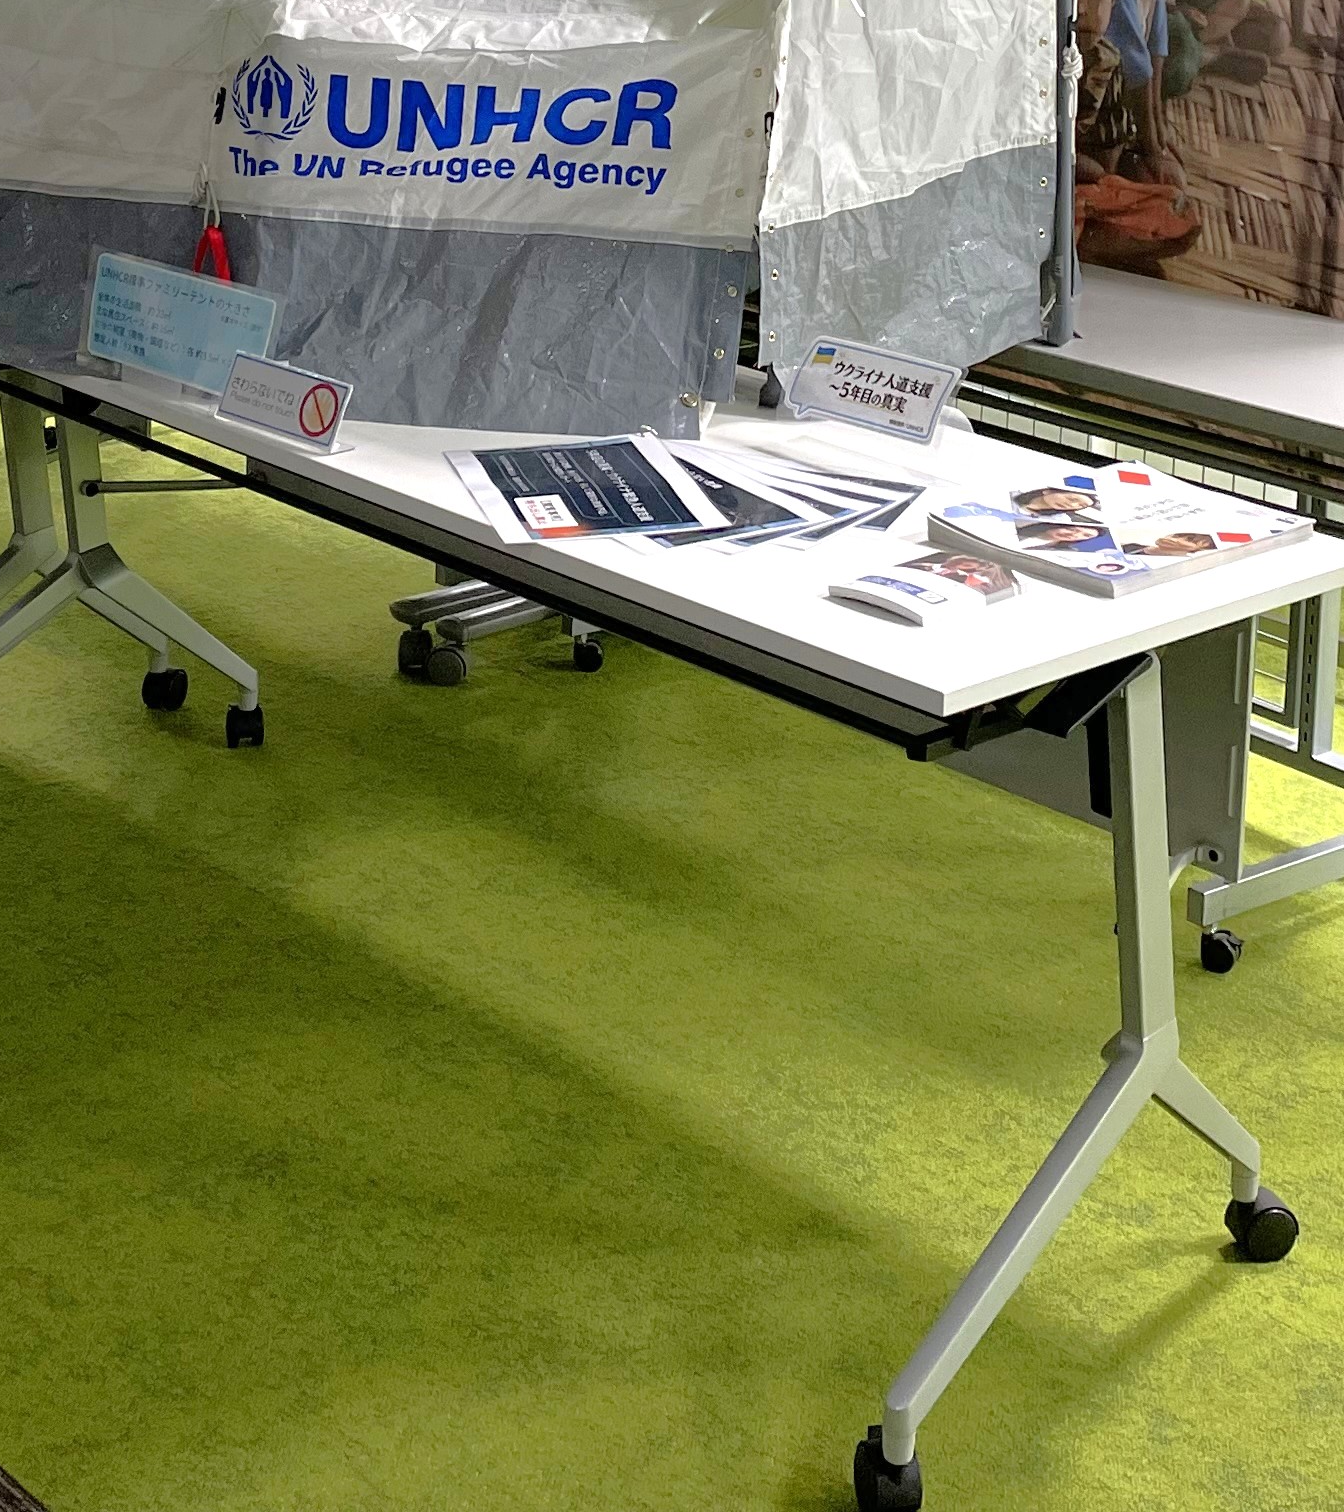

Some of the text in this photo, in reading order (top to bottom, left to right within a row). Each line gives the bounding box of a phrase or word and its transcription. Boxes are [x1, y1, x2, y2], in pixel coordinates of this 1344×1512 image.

[326, 73, 679, 153] UNHCR
[229, 146, 279, 177] The
[292, 153, 346, 180] UN
[527, 153, 668, 196] Agency
[231, 376, 302, 408] さわらないでね!
[829, 381, 908, 414] 〜5年目の真実
[834, 360, 935, 399] ウクライナ人道支援
